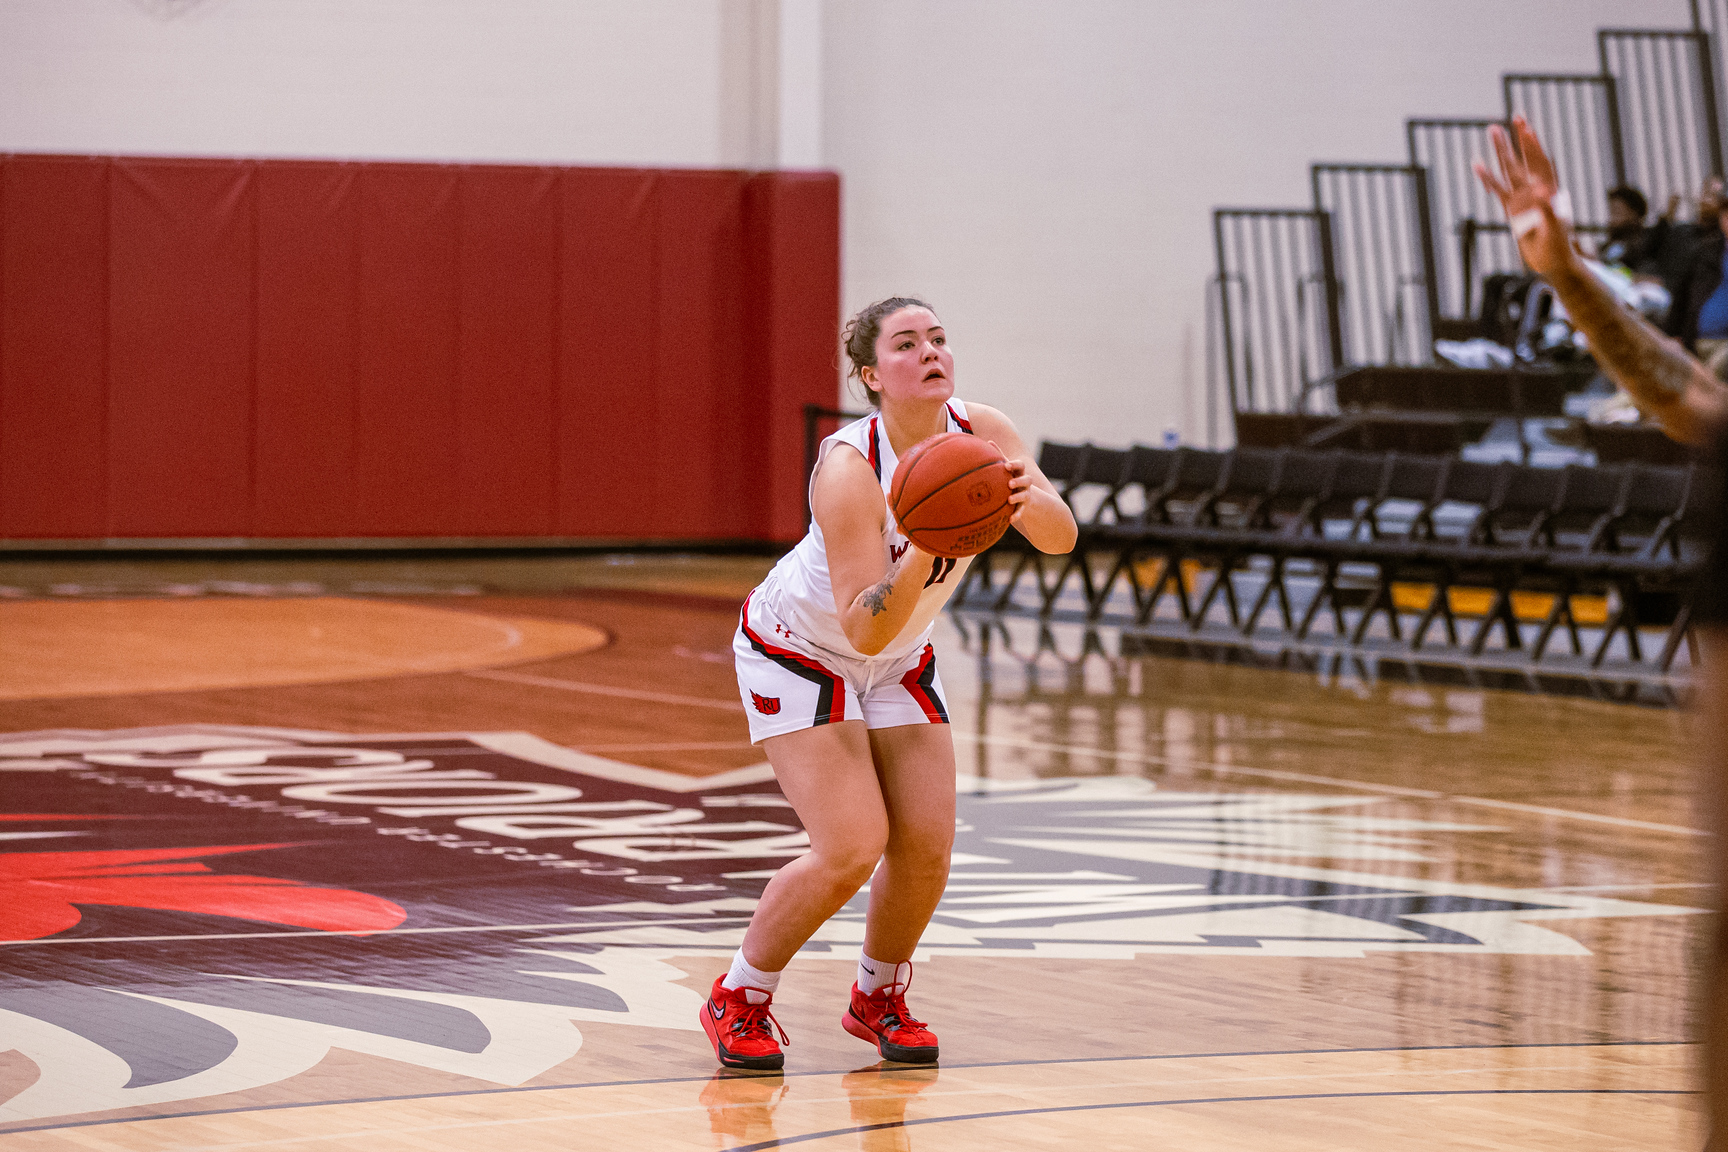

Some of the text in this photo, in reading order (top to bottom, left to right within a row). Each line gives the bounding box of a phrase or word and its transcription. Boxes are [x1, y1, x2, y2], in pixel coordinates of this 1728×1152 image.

[889, 540, 912, 563] W
[762, 697, 780, 712] RU
[377, 826, 727, 892] ROCHESTER
